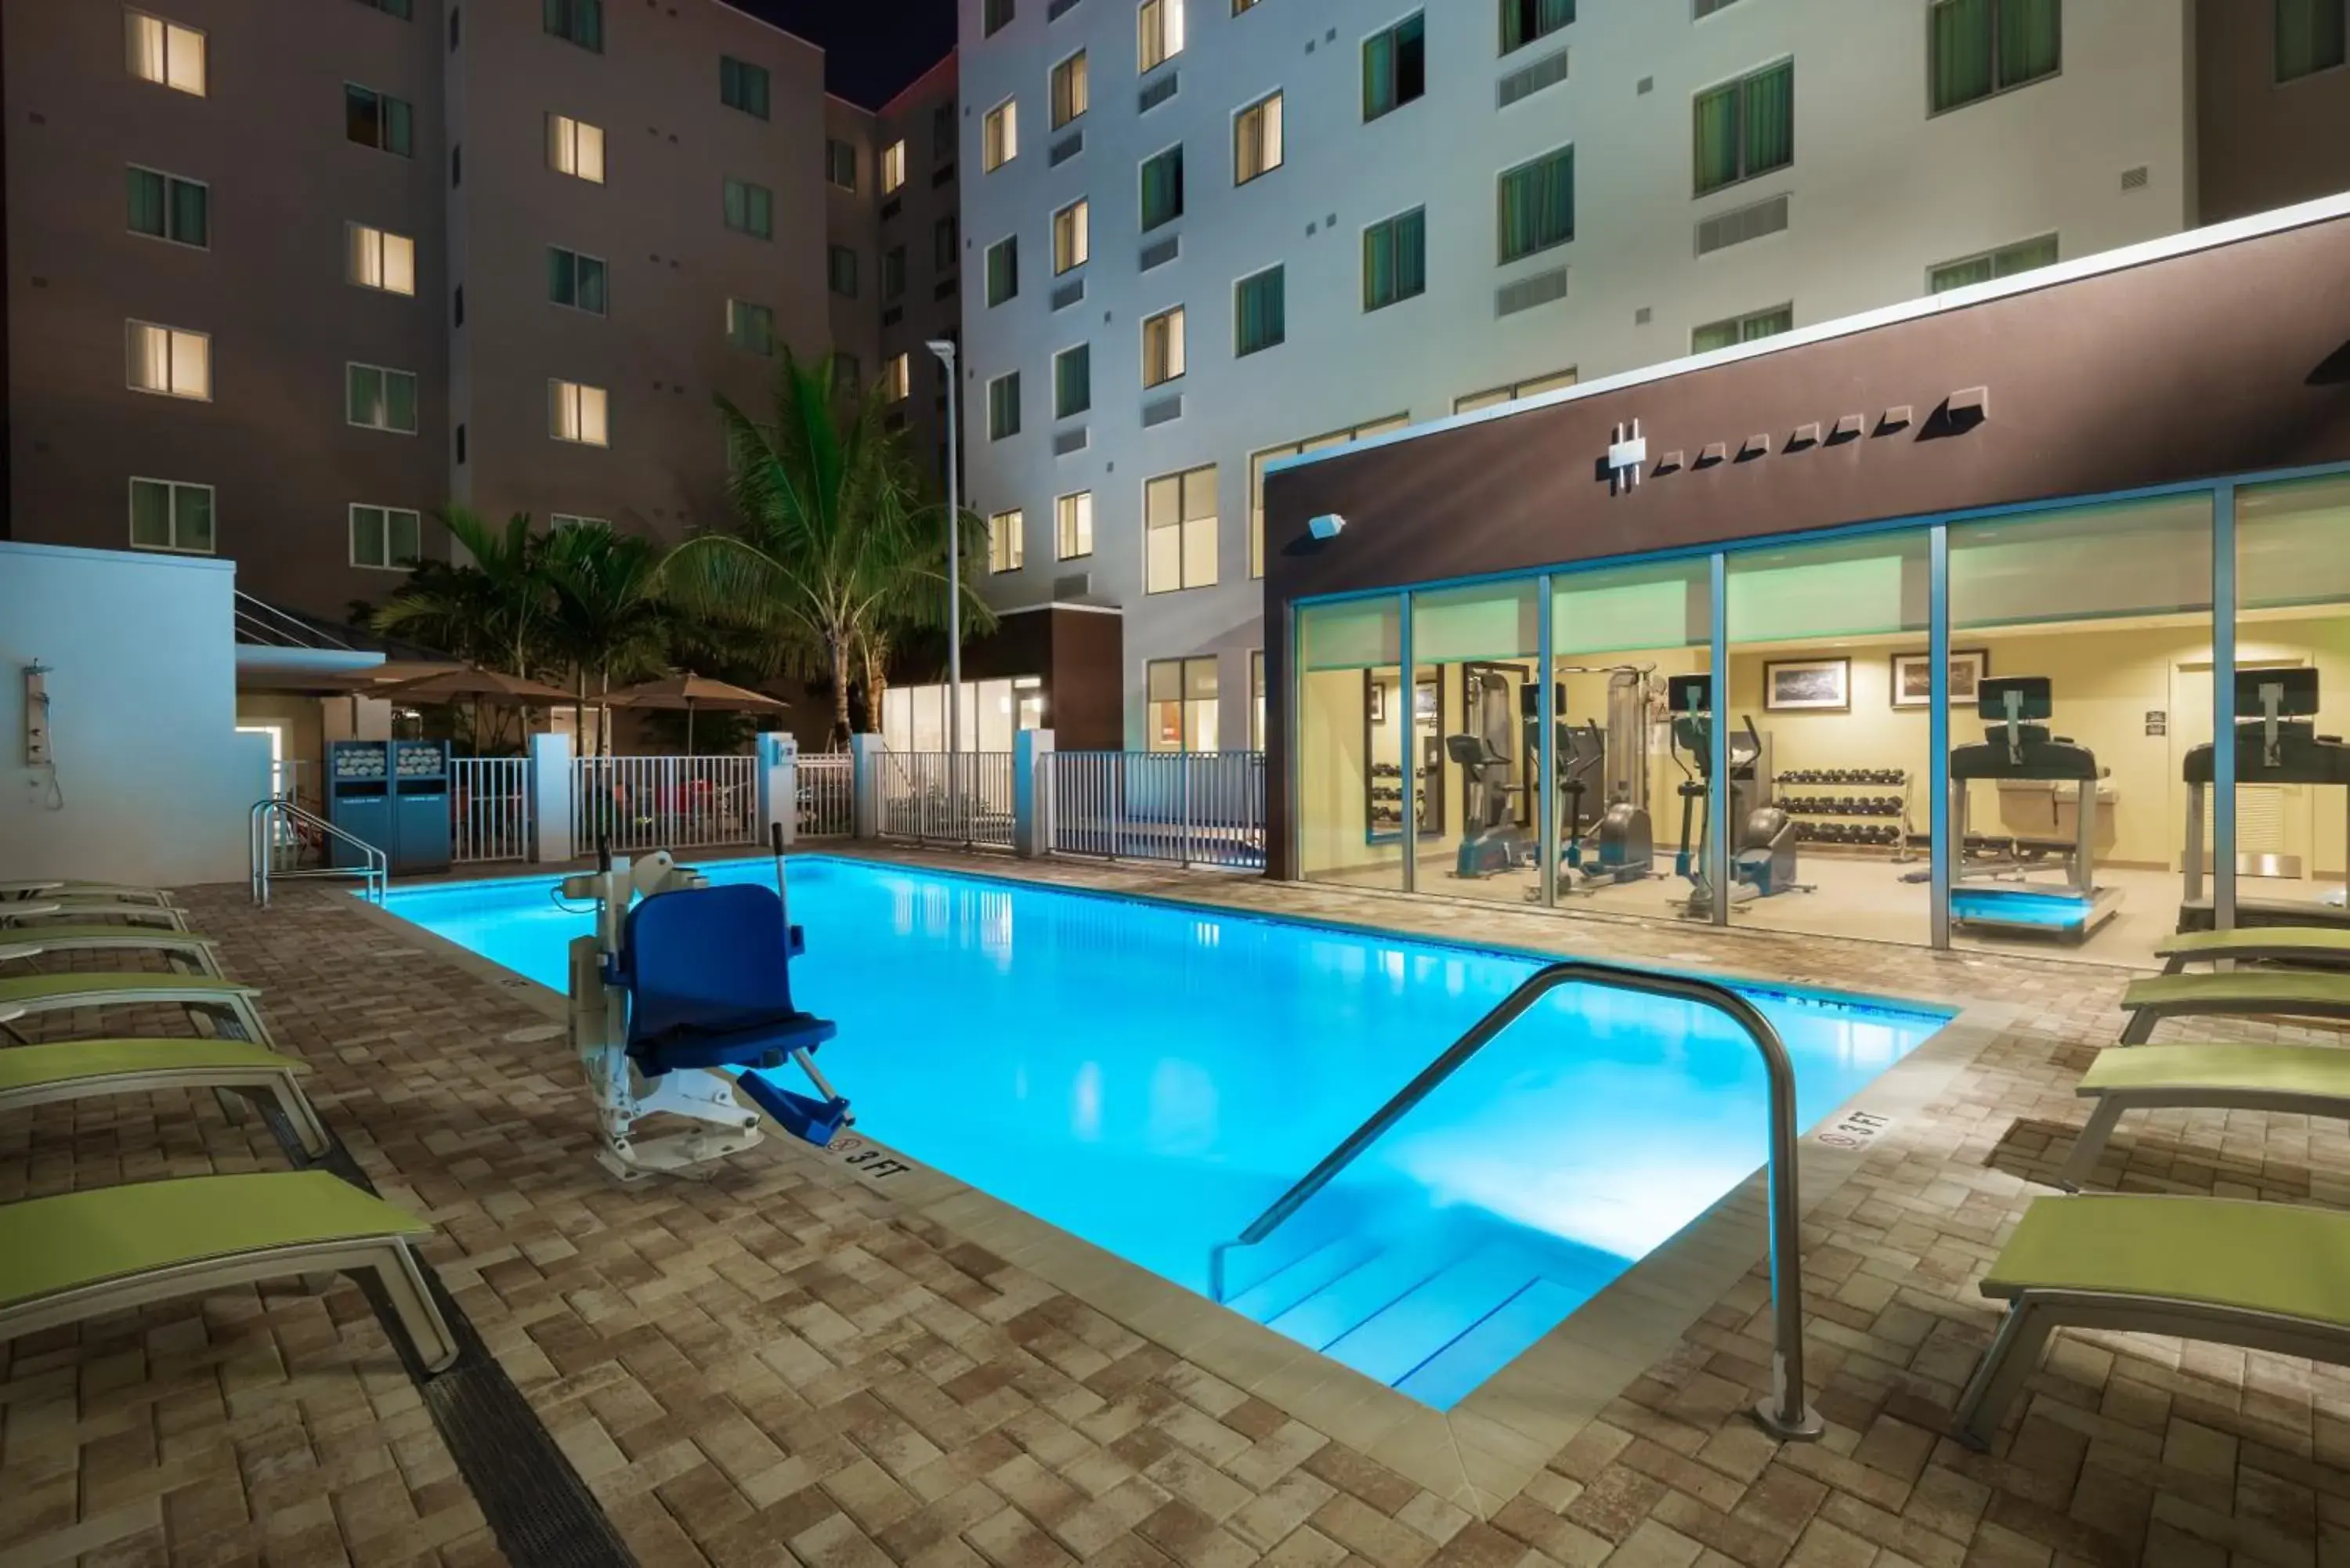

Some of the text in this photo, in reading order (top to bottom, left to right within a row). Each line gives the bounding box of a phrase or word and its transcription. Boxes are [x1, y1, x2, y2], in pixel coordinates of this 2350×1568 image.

[1838, 1111, 1889, 1135] 3 FT
[844, 1150, 911, 1179] 3 FT
